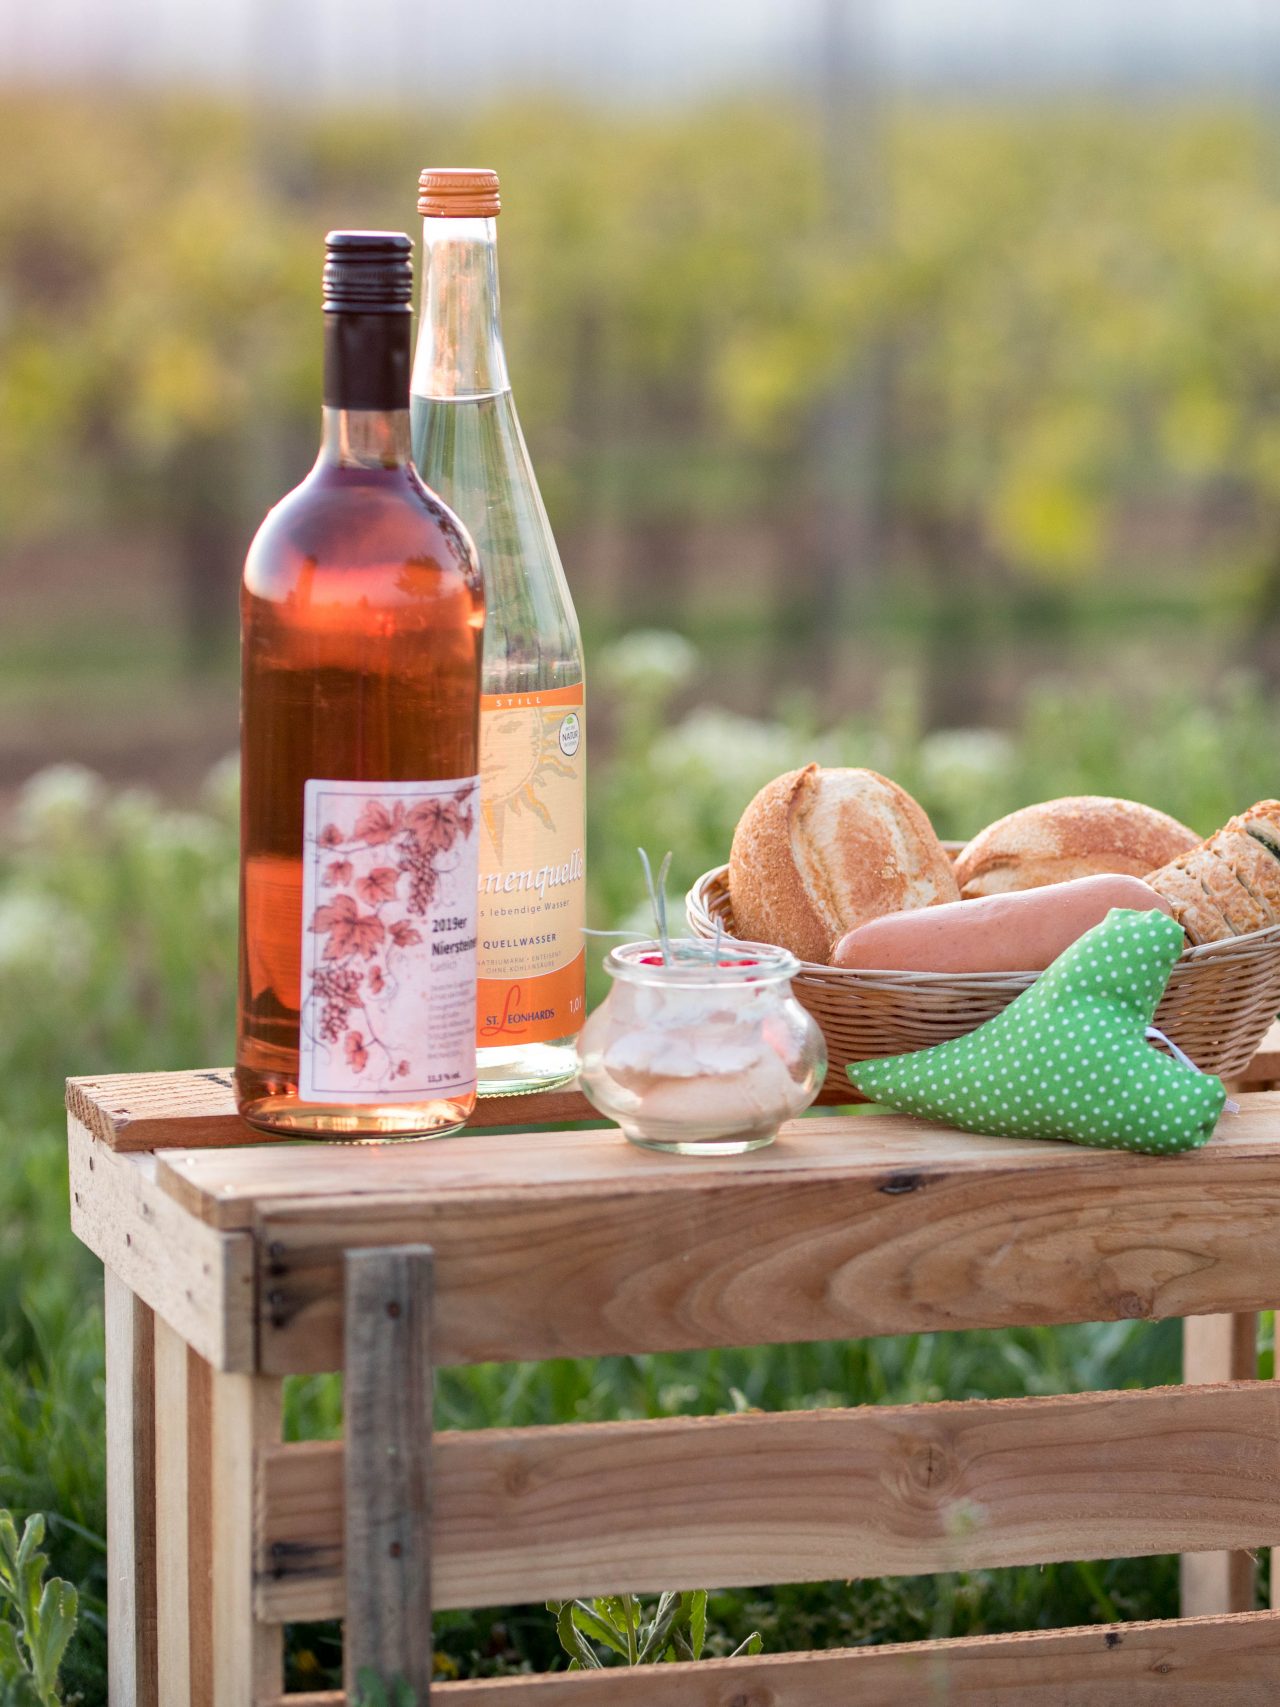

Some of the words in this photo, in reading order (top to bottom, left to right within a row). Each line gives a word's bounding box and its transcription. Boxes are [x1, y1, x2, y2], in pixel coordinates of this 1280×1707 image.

[496, 697, 541, 707] STILL
[562, 730, 579, 742] NATUR
[490, 905, 541, 917] lebendige
[544, 899, 570, 911] Wasser
[432, 917, 467, 933] 2019er
[483, 933, 557, 949] QUELLWASSER
[486, 1015, 499, 1026] ST.
